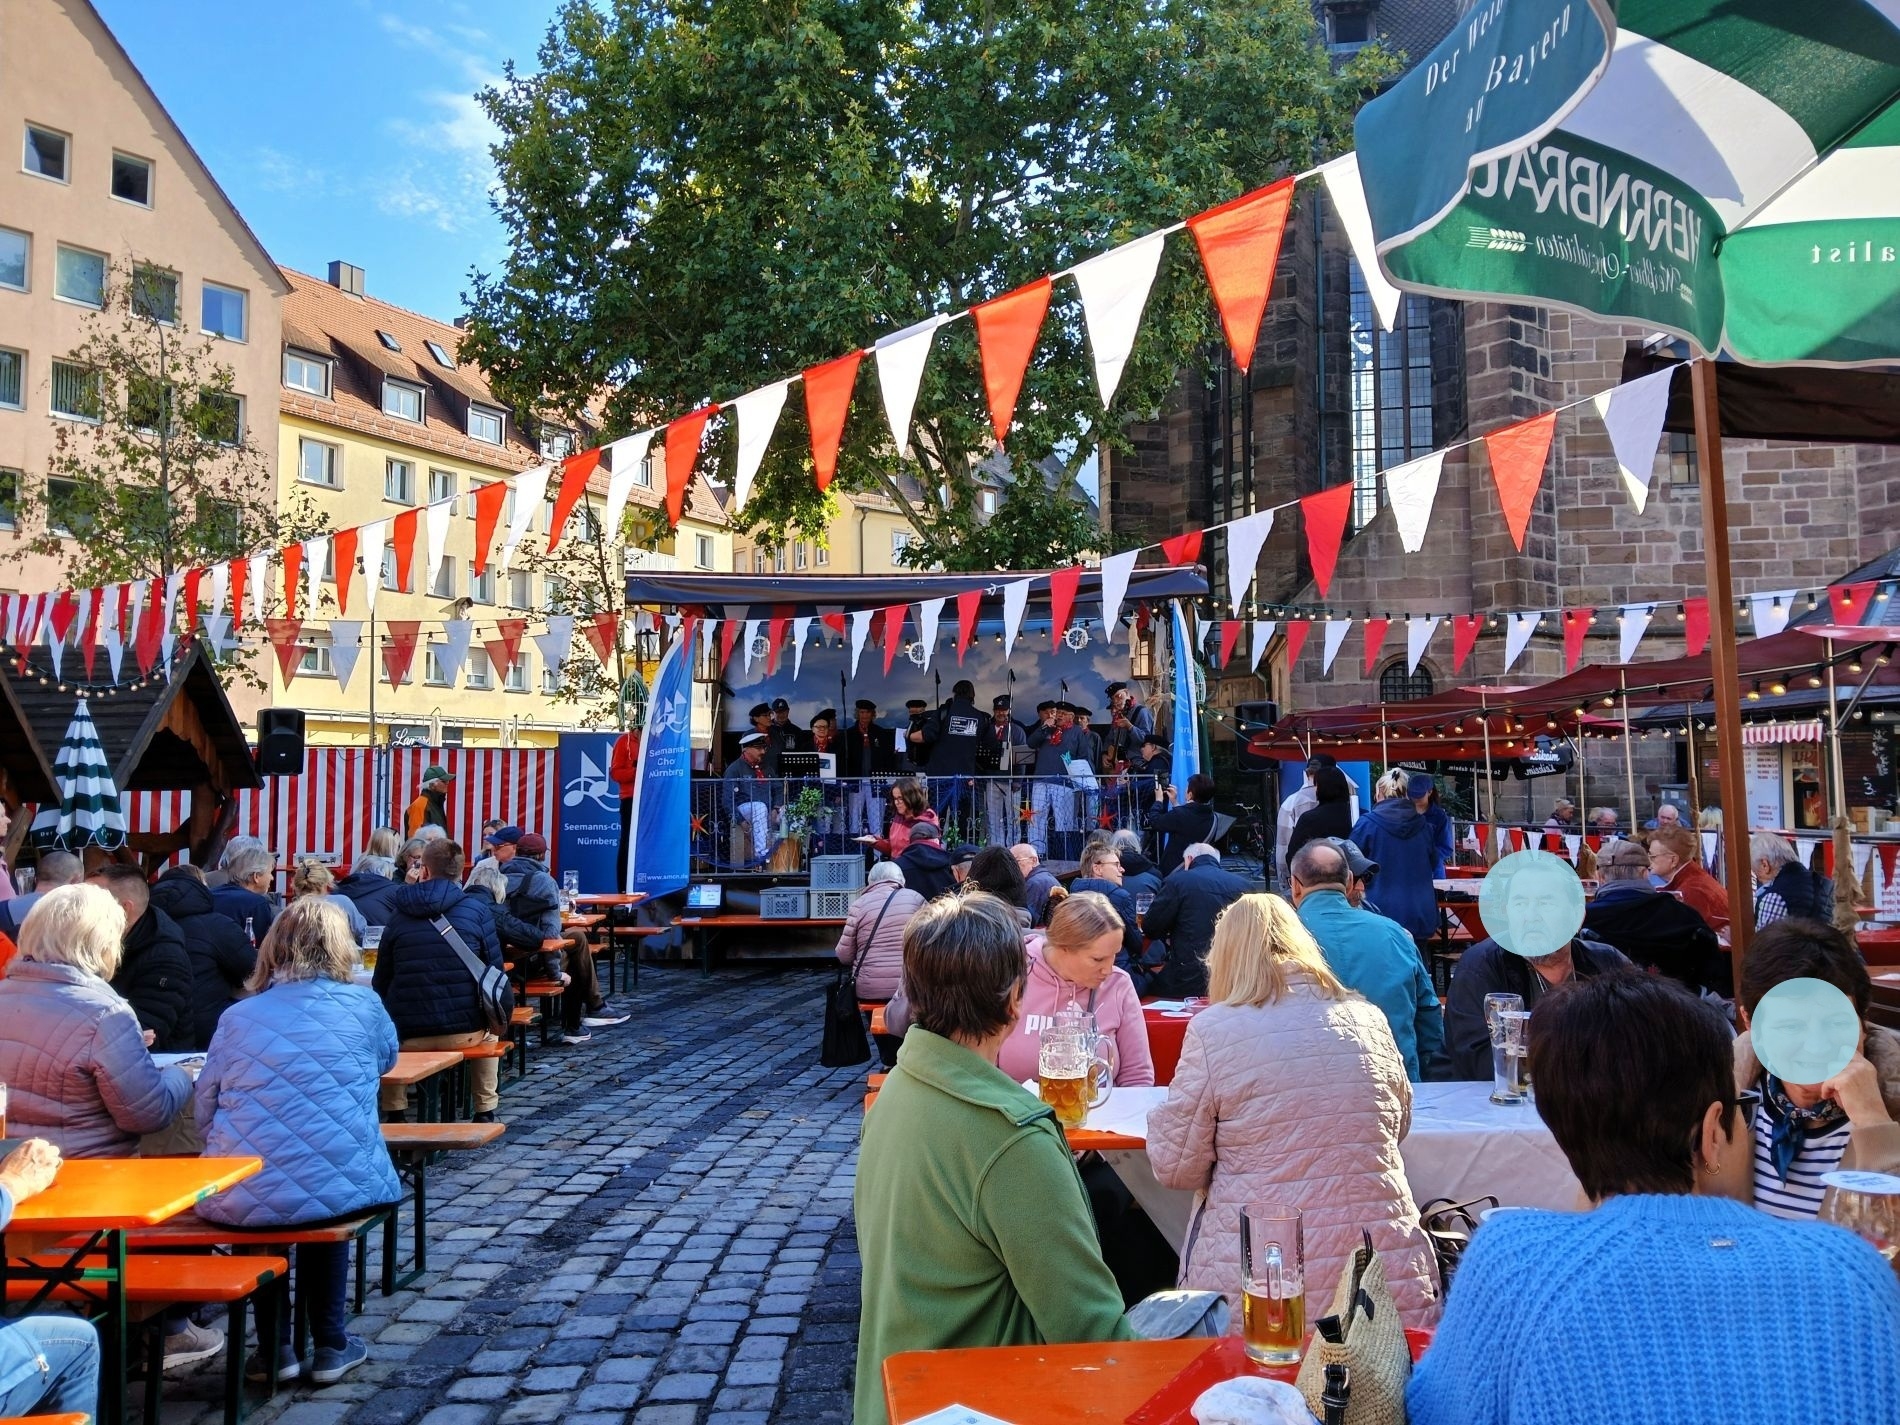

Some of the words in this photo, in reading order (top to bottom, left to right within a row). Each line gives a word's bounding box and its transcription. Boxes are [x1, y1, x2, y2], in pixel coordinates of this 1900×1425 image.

[1425, 48, 1460, 97] Der
[1485, 4, 1571, 93] Bayern
[577, 837, 618, 847] Nürnberg
